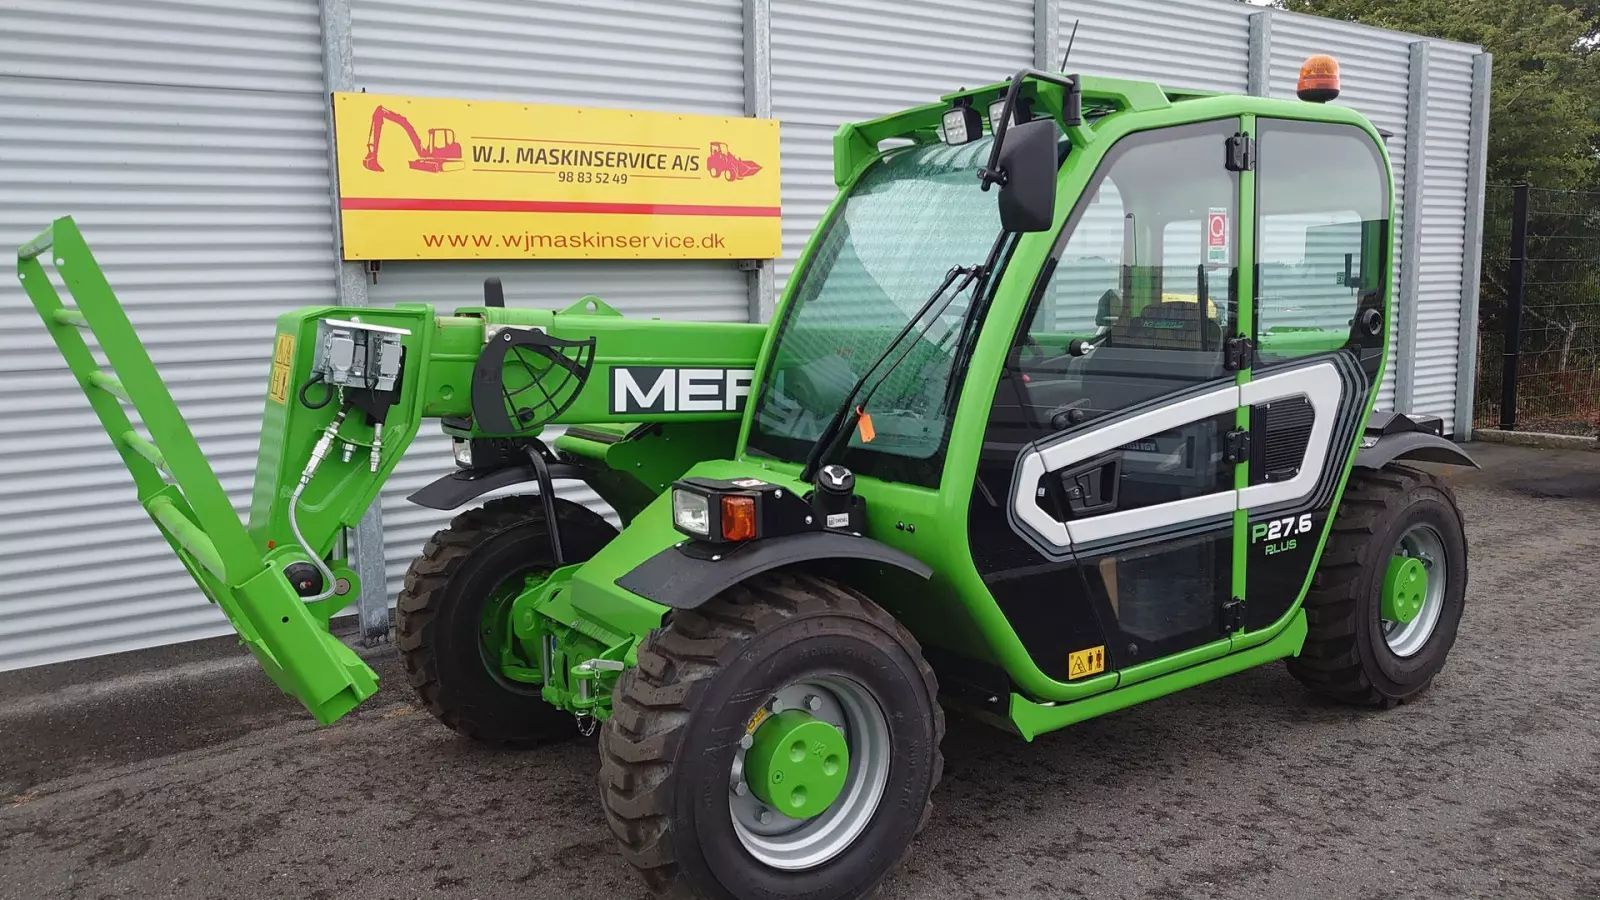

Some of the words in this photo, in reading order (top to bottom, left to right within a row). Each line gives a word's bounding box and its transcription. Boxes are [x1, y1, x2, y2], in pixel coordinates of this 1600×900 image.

[472, 145, 510, 164] W.J.
[516, 149, 667, 170] MASKINSERVICE
[671, 154, 700, 171] A/S
[558, 171, 575, 183] 98
[577, 171, 592, 184] 83
[595, 172, 609, 184] 52
[612, 173, 628, 185] 49
[423, 231, 725, 251] www.wjmaskinservice.dk
